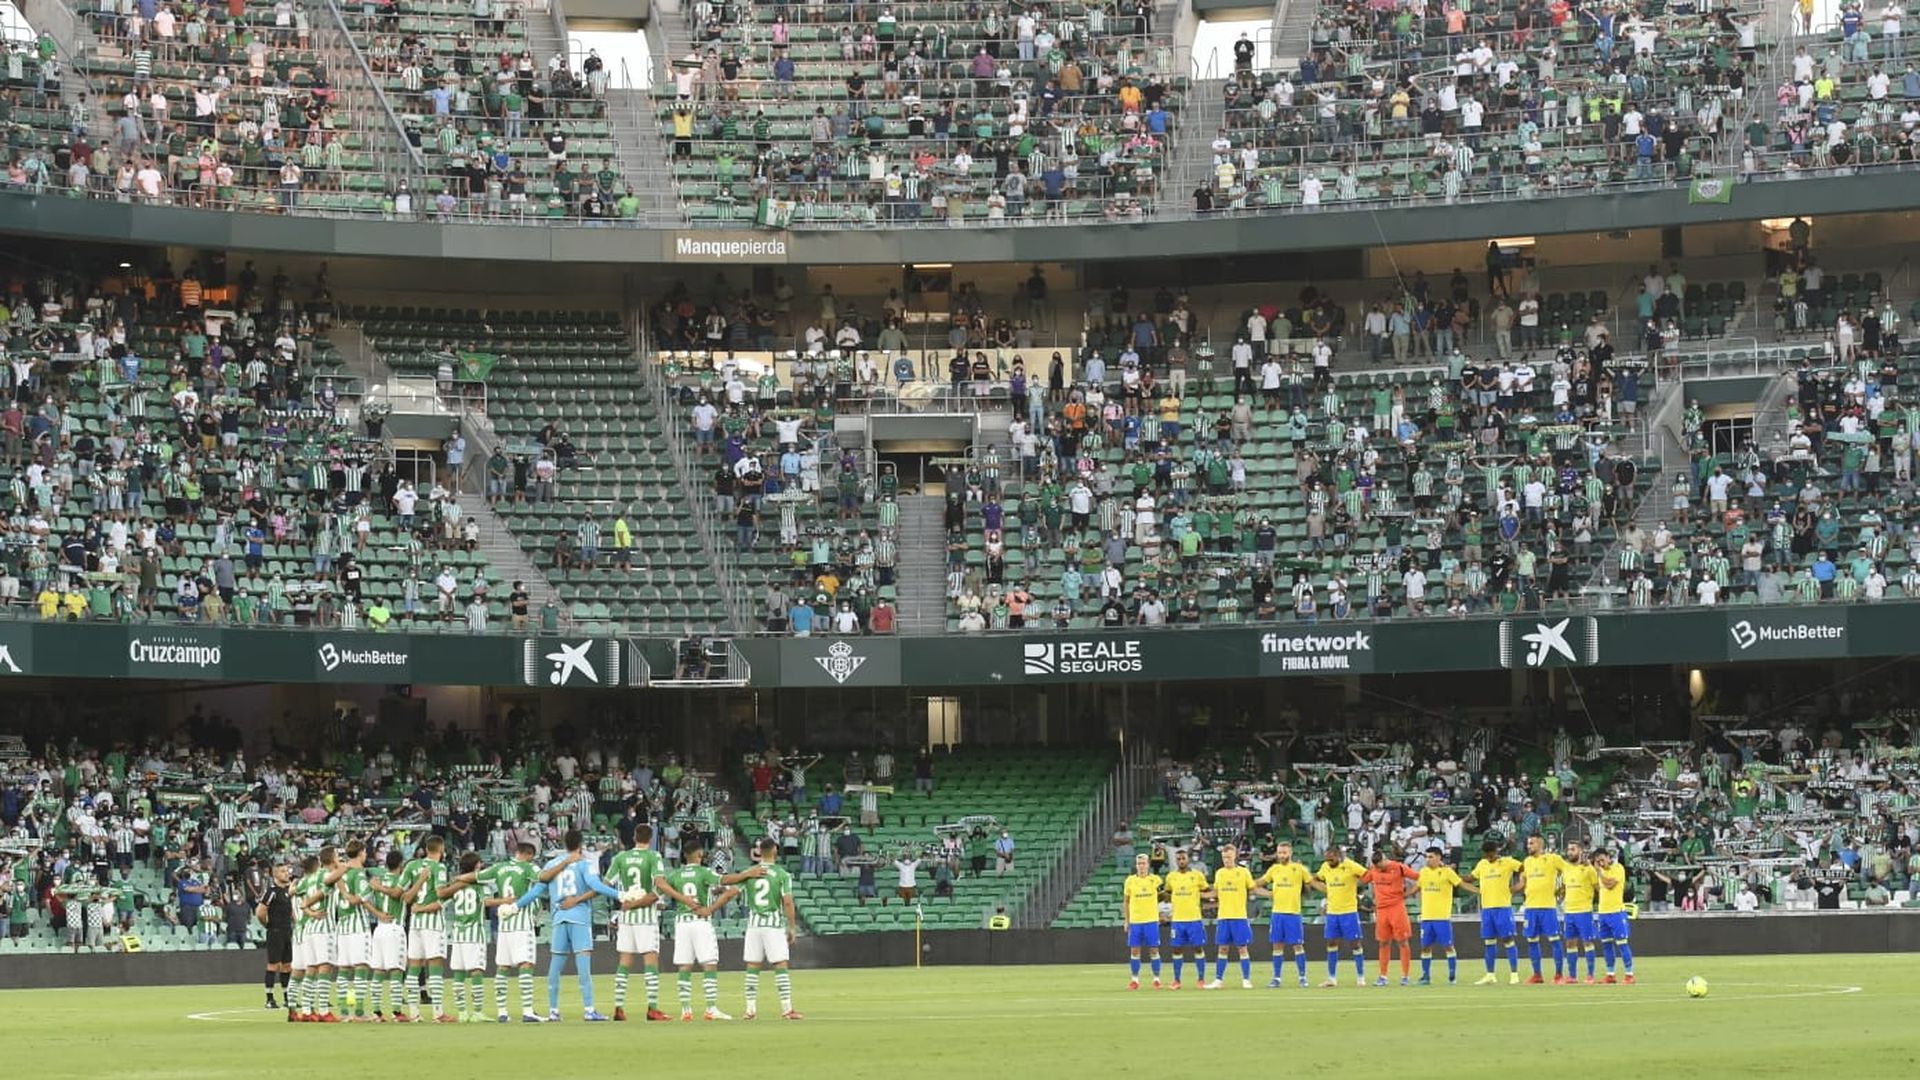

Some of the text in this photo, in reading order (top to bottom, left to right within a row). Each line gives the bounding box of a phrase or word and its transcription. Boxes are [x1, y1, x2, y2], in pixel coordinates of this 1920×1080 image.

[677, 238, 786, 258] Manquepierda
[1261, 630, 1371, 653] finetwork
[1759, 624, 1844, 640] MuchBetter
[129, 638, 221, 668] Cruzcampo
[341, 648, 408, 666] MuchBetter
[1060, 641, 1141, 659] REALE
[1060, 659, 1142, 674] SEGUROS
[1282, 654, 1350, 670] FIBRA & MÓVIL
[502, 876, 515, 899] 6
[754, 878, 770, 907] 2
[453, 887, 477, 915] 28
